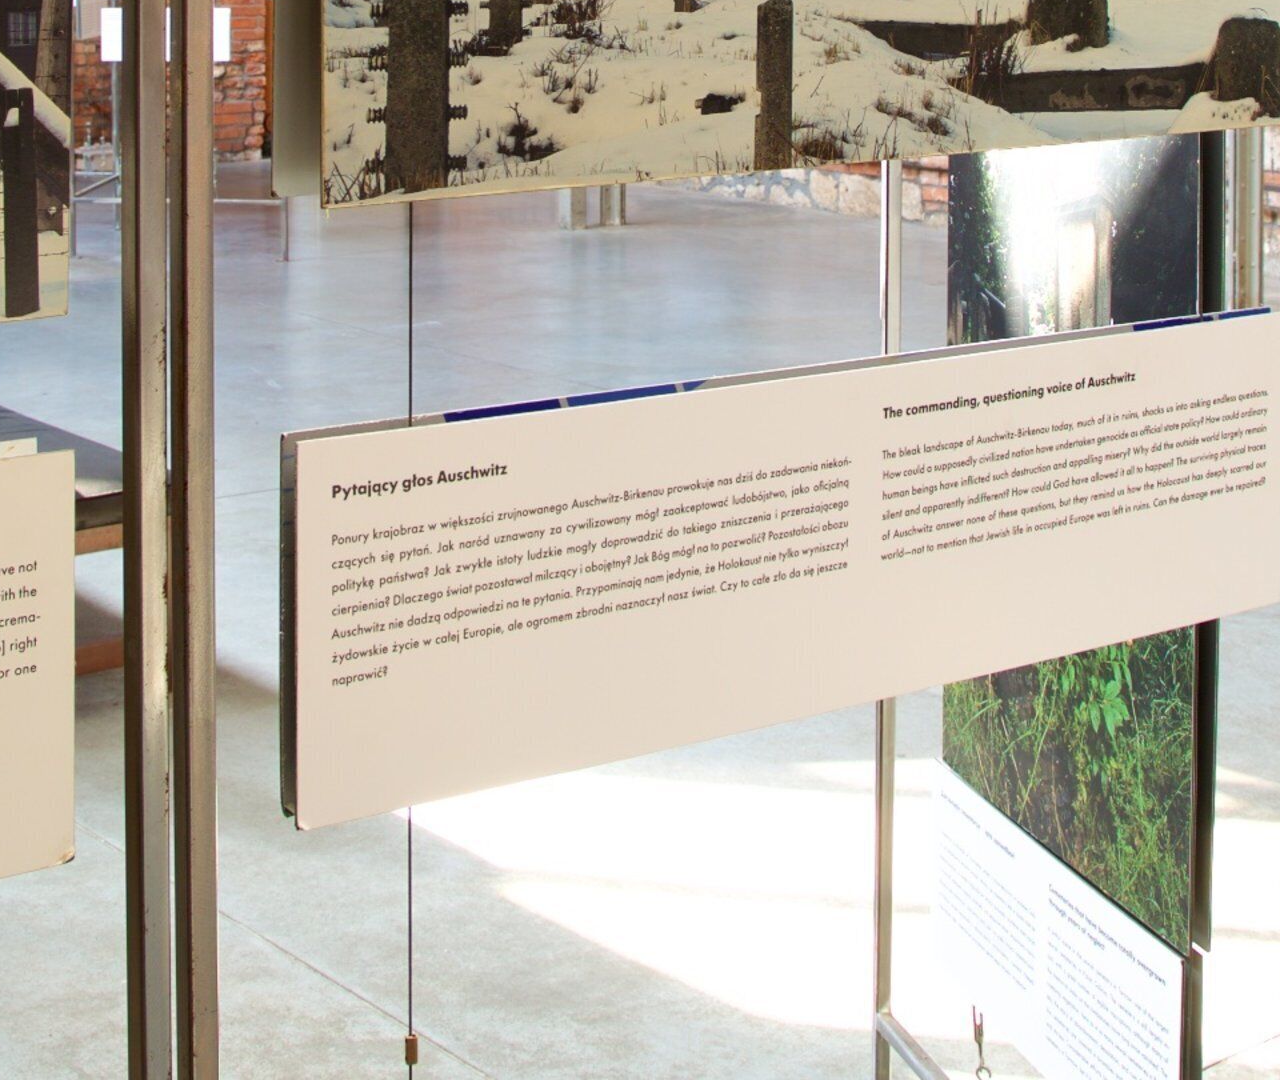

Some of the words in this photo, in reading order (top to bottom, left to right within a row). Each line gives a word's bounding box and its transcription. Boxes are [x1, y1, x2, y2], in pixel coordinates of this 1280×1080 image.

[882, 406, 903, 419] The
[906, 396, 980, 416] commanding,
[982, 386, 1044, 407] questioning
[1046, 381, 1072, 394] voice
[1075, 377, 1086, 390] of
[1087, 372, 1136, 388] Auschwitz
[332, 480, 398, 501] Pytający
[402, 474, 433, 492] głos
[436, 464, 508, 484] Auschwitz
[332, 533, 369, 546] Ponury
[373, 524, 424, 540] krajobraz
[440, 512, 494, 530] większości
[498, 504, 568, 521] zrujnowanego
[572, 488, 664, 509] Auschwitz-Birkenau
[667, 478, 714, 497] prowokuje
[717, 478, 733, 486] nas
[736, 472, 753, 484] dziś
[756, 470, 767, 480] do
[770, 462, 818, 478] zadawania
[821, 456, 852, 470] niekoń-
[332, 552, 376, 570] czących
[381, 550, 395, 563] się
[400, 544, 432, 562] pytań.
[437, 540, 454, 553] Jak
[459, 534, 490, 549] naród
[494, 529, 545, 544] uznawany
[550, 526, 562, 535] za
[566, 516, 631, 534] cywilizowany
[636, 508, 659, 522] mógł
[663, 496, 728, 516] zaakceptować
[732, 490, 787, 505] ludobójstwo,
[792, 484, 810, 498] jako
[813, 478, 849, 492] oficjalną
[18, 560, 37, 573] not
[332, 576, 374, 596] politykę
[380, 566, 429, 588] państwa?
[434, 563, 451, 576] Jak
[456, 557, 492, 573] zwykłe
[497, 554, 523, 566] istoty
[528, 546, 562, 560] ludzkie
[566, 540, 597, 555] mogły
[601, 529, 663, 549] doprowadzić
[666, 526, 679, 538] do
[683, 522, 717, 535] takiego
[721, 512, 771, 528] zniszczenia
[775, 509, 778, 518] i
[781, 500, 849, 520] przerażającego
[19, 586, 37, 598] the
